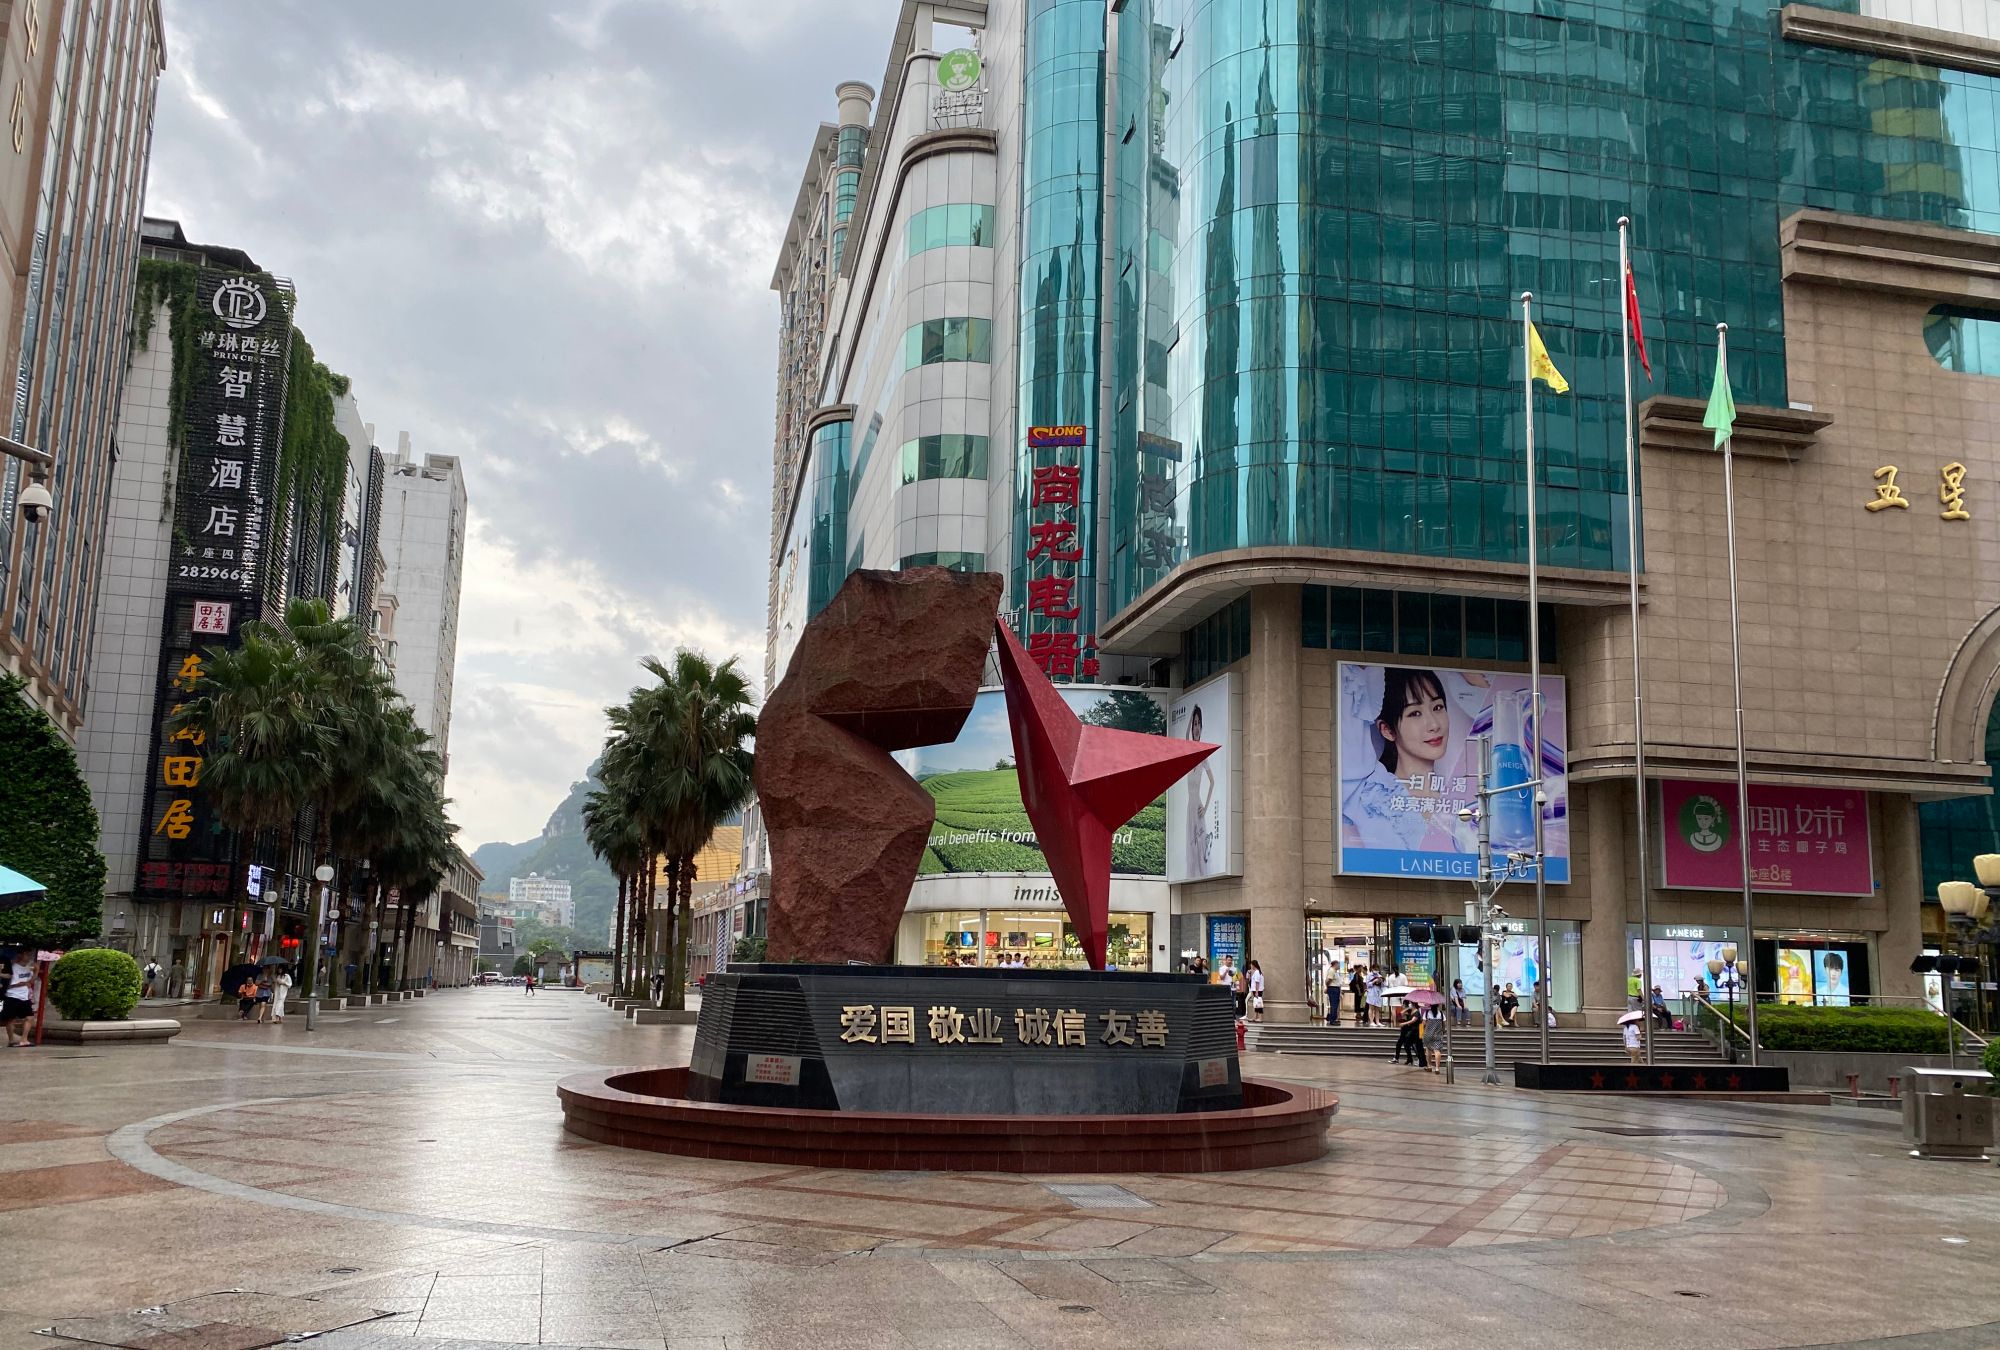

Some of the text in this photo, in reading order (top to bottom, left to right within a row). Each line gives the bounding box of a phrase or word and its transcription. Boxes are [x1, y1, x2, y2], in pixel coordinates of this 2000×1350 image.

[201, 366, 252, 537] 智慧酒店
[180, 566, 249, 580] 2829666
[1026, 464, 1084, 676] 尚龙电器
[949, 829, 997, 846] benefits
[1000, 828, 1036, 844] from
[1738, 839, 1848, 855] 生态椰子鸡
[1400, 857, 1473, 875] LANEIGE
[1013, 885, 1062, 902] innis
[1666, 928, 1705, 938] LANEIGE
[840, 1004, 1170, 1048] 爱国 敬业 诚信 友善
